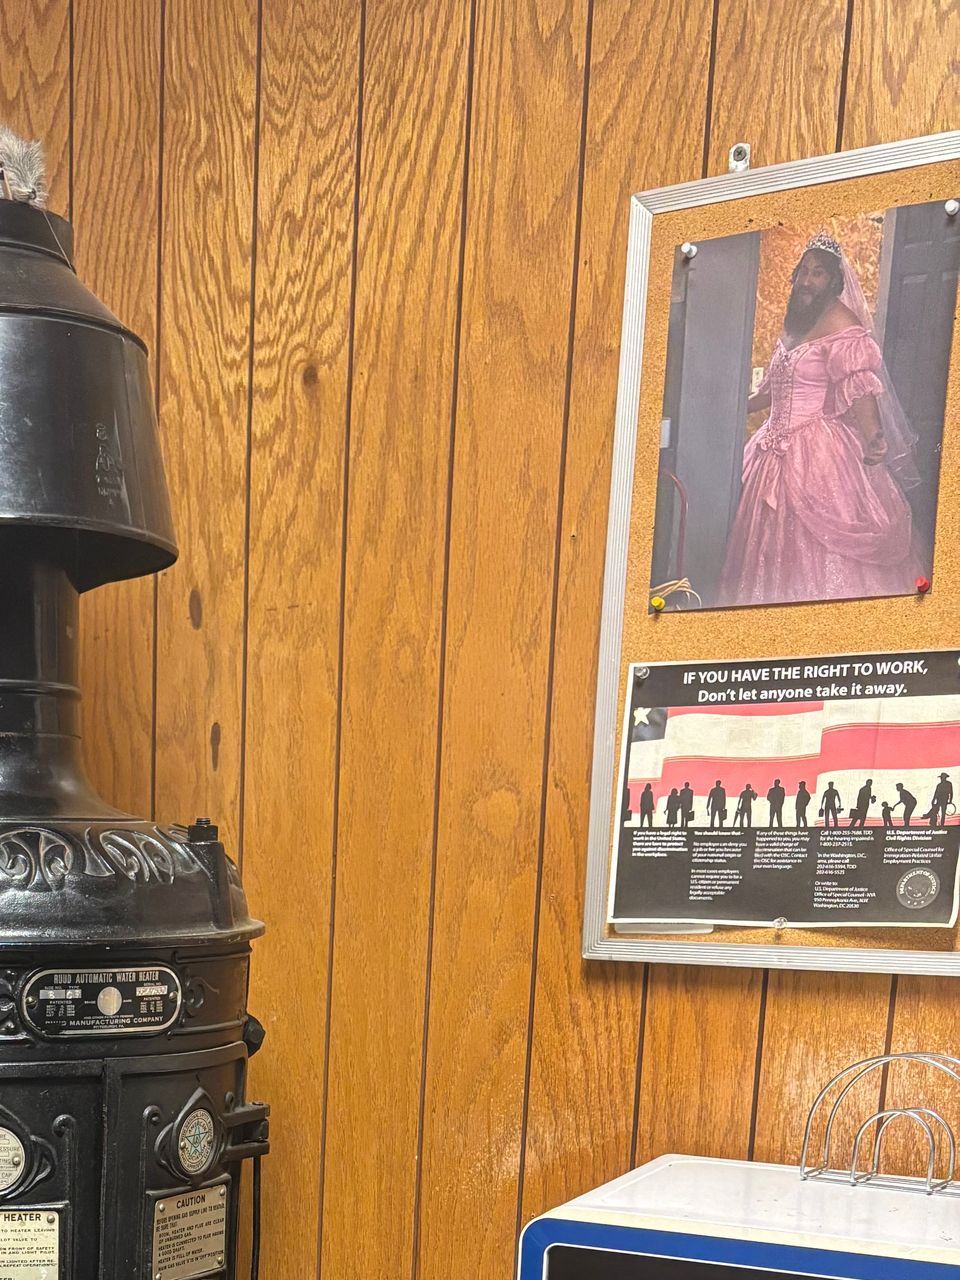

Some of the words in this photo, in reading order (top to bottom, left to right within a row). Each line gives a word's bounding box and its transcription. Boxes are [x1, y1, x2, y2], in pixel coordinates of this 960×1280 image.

[684, 672, 696, 684] IF
[698, 670, 728, 683] YOU
[731, 668, 769, 682] HAVE
[773, 667, 801, 679] THE
[804, 664, 850, 678] RIGHT
[852, 663, 873, 676] TO
[876, 660, 928, 675] WORK,
[698, 689, 736, 702] Don't
[739, 688, 757, 700] let
[760, 688, 813, 702] anyone
[816, 684, 848, 697] take
[851, 683, 862, 695] it
[864, 684, 908, 696] away.
[54, 974, 71, 984] RUUD
[76, 973, 112, 984] AUTOMATIC
[116, 972, 136, 982] WATER
[139, 971, 159, 981] HEATER
[176, 1194, 206, 1209] CAUTION
[4, 1213, 41, 1221] HEATER
